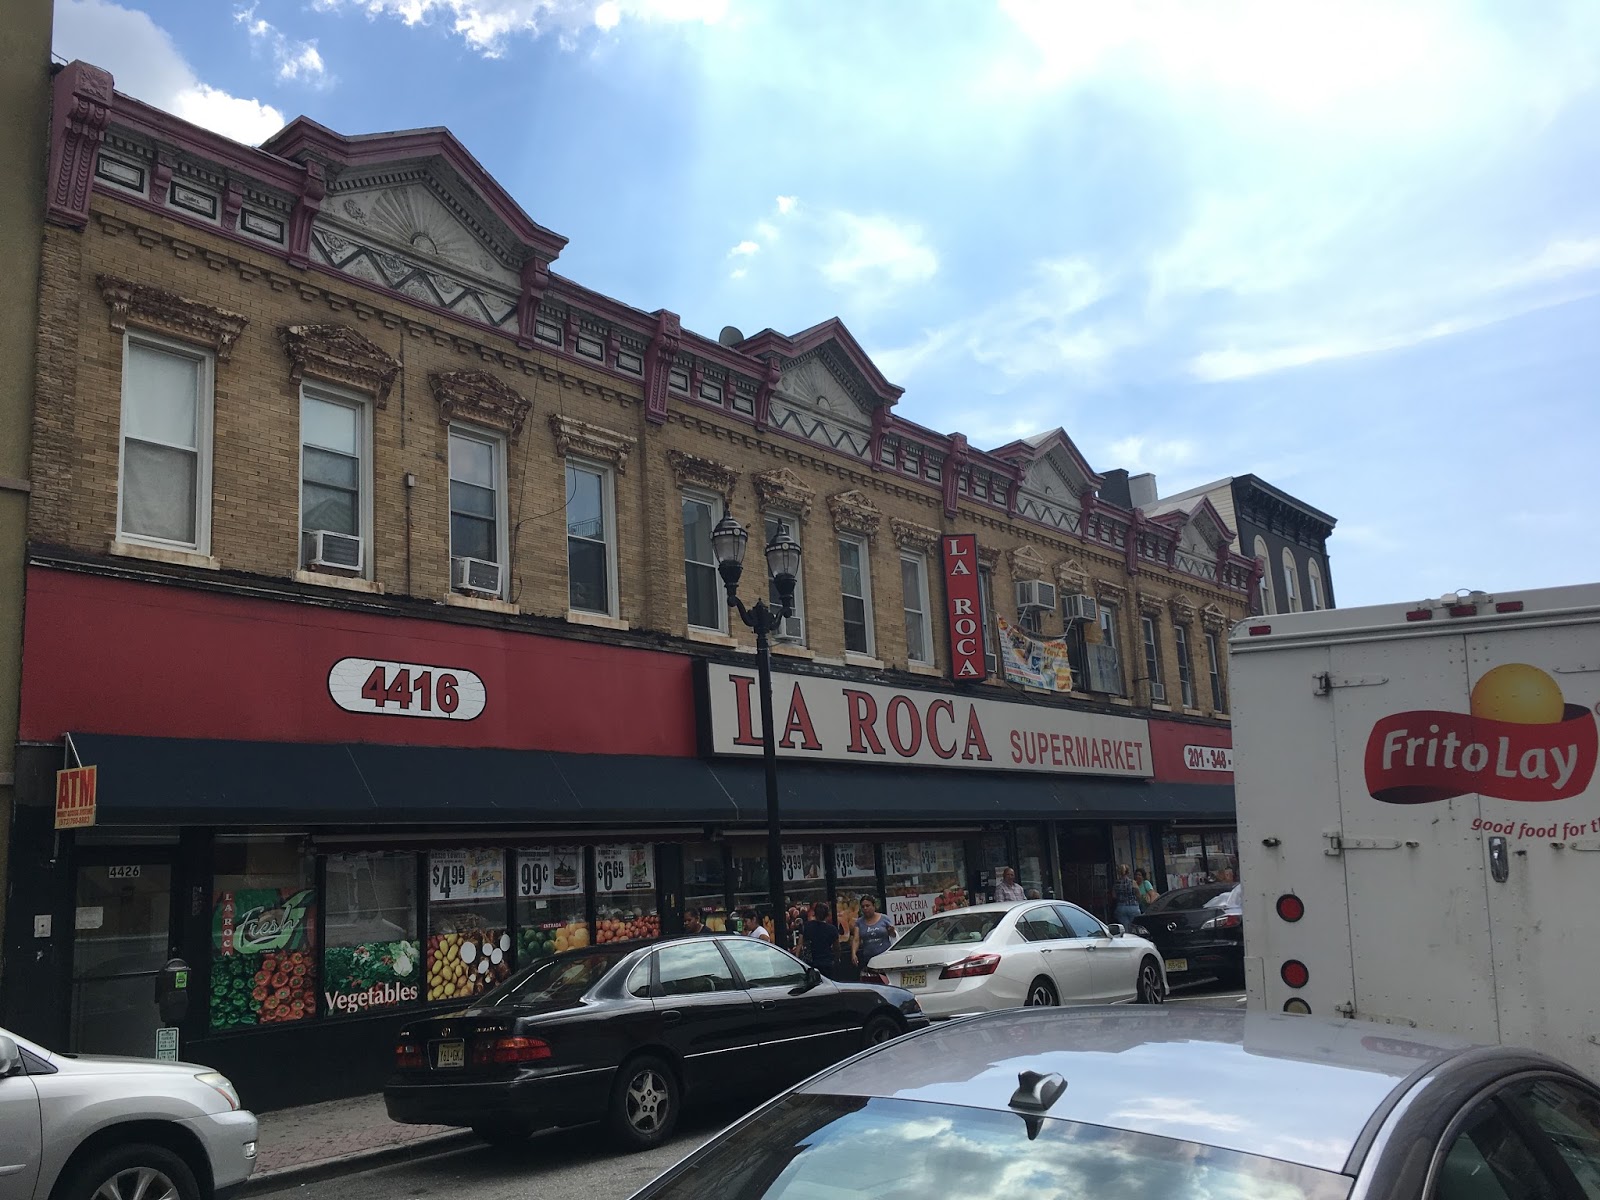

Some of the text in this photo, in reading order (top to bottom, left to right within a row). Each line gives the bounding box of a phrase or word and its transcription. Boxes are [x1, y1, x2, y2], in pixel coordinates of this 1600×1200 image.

[949, 539, 978, 676] LA ROCA
[361, 666, 460, 713] 4416
[728, 673, 993, 761] LA ROCA
[1010, 729, 1142, 770] SUPERMARKET
[57, 769, 95, 809] ATM
[1471, 817, 1515, 835] good
[1518, 822, 1557, 839] food
[1563, 822, 1587, 840] for
[110, 866, 139, 877] 4426
[236, 904, 300, 948] Fresh
[890, 900, 928, 912] CARNICERIA
[894, 914, 905, 926] LA
[324, 981, 418, 1014] Vegetables
